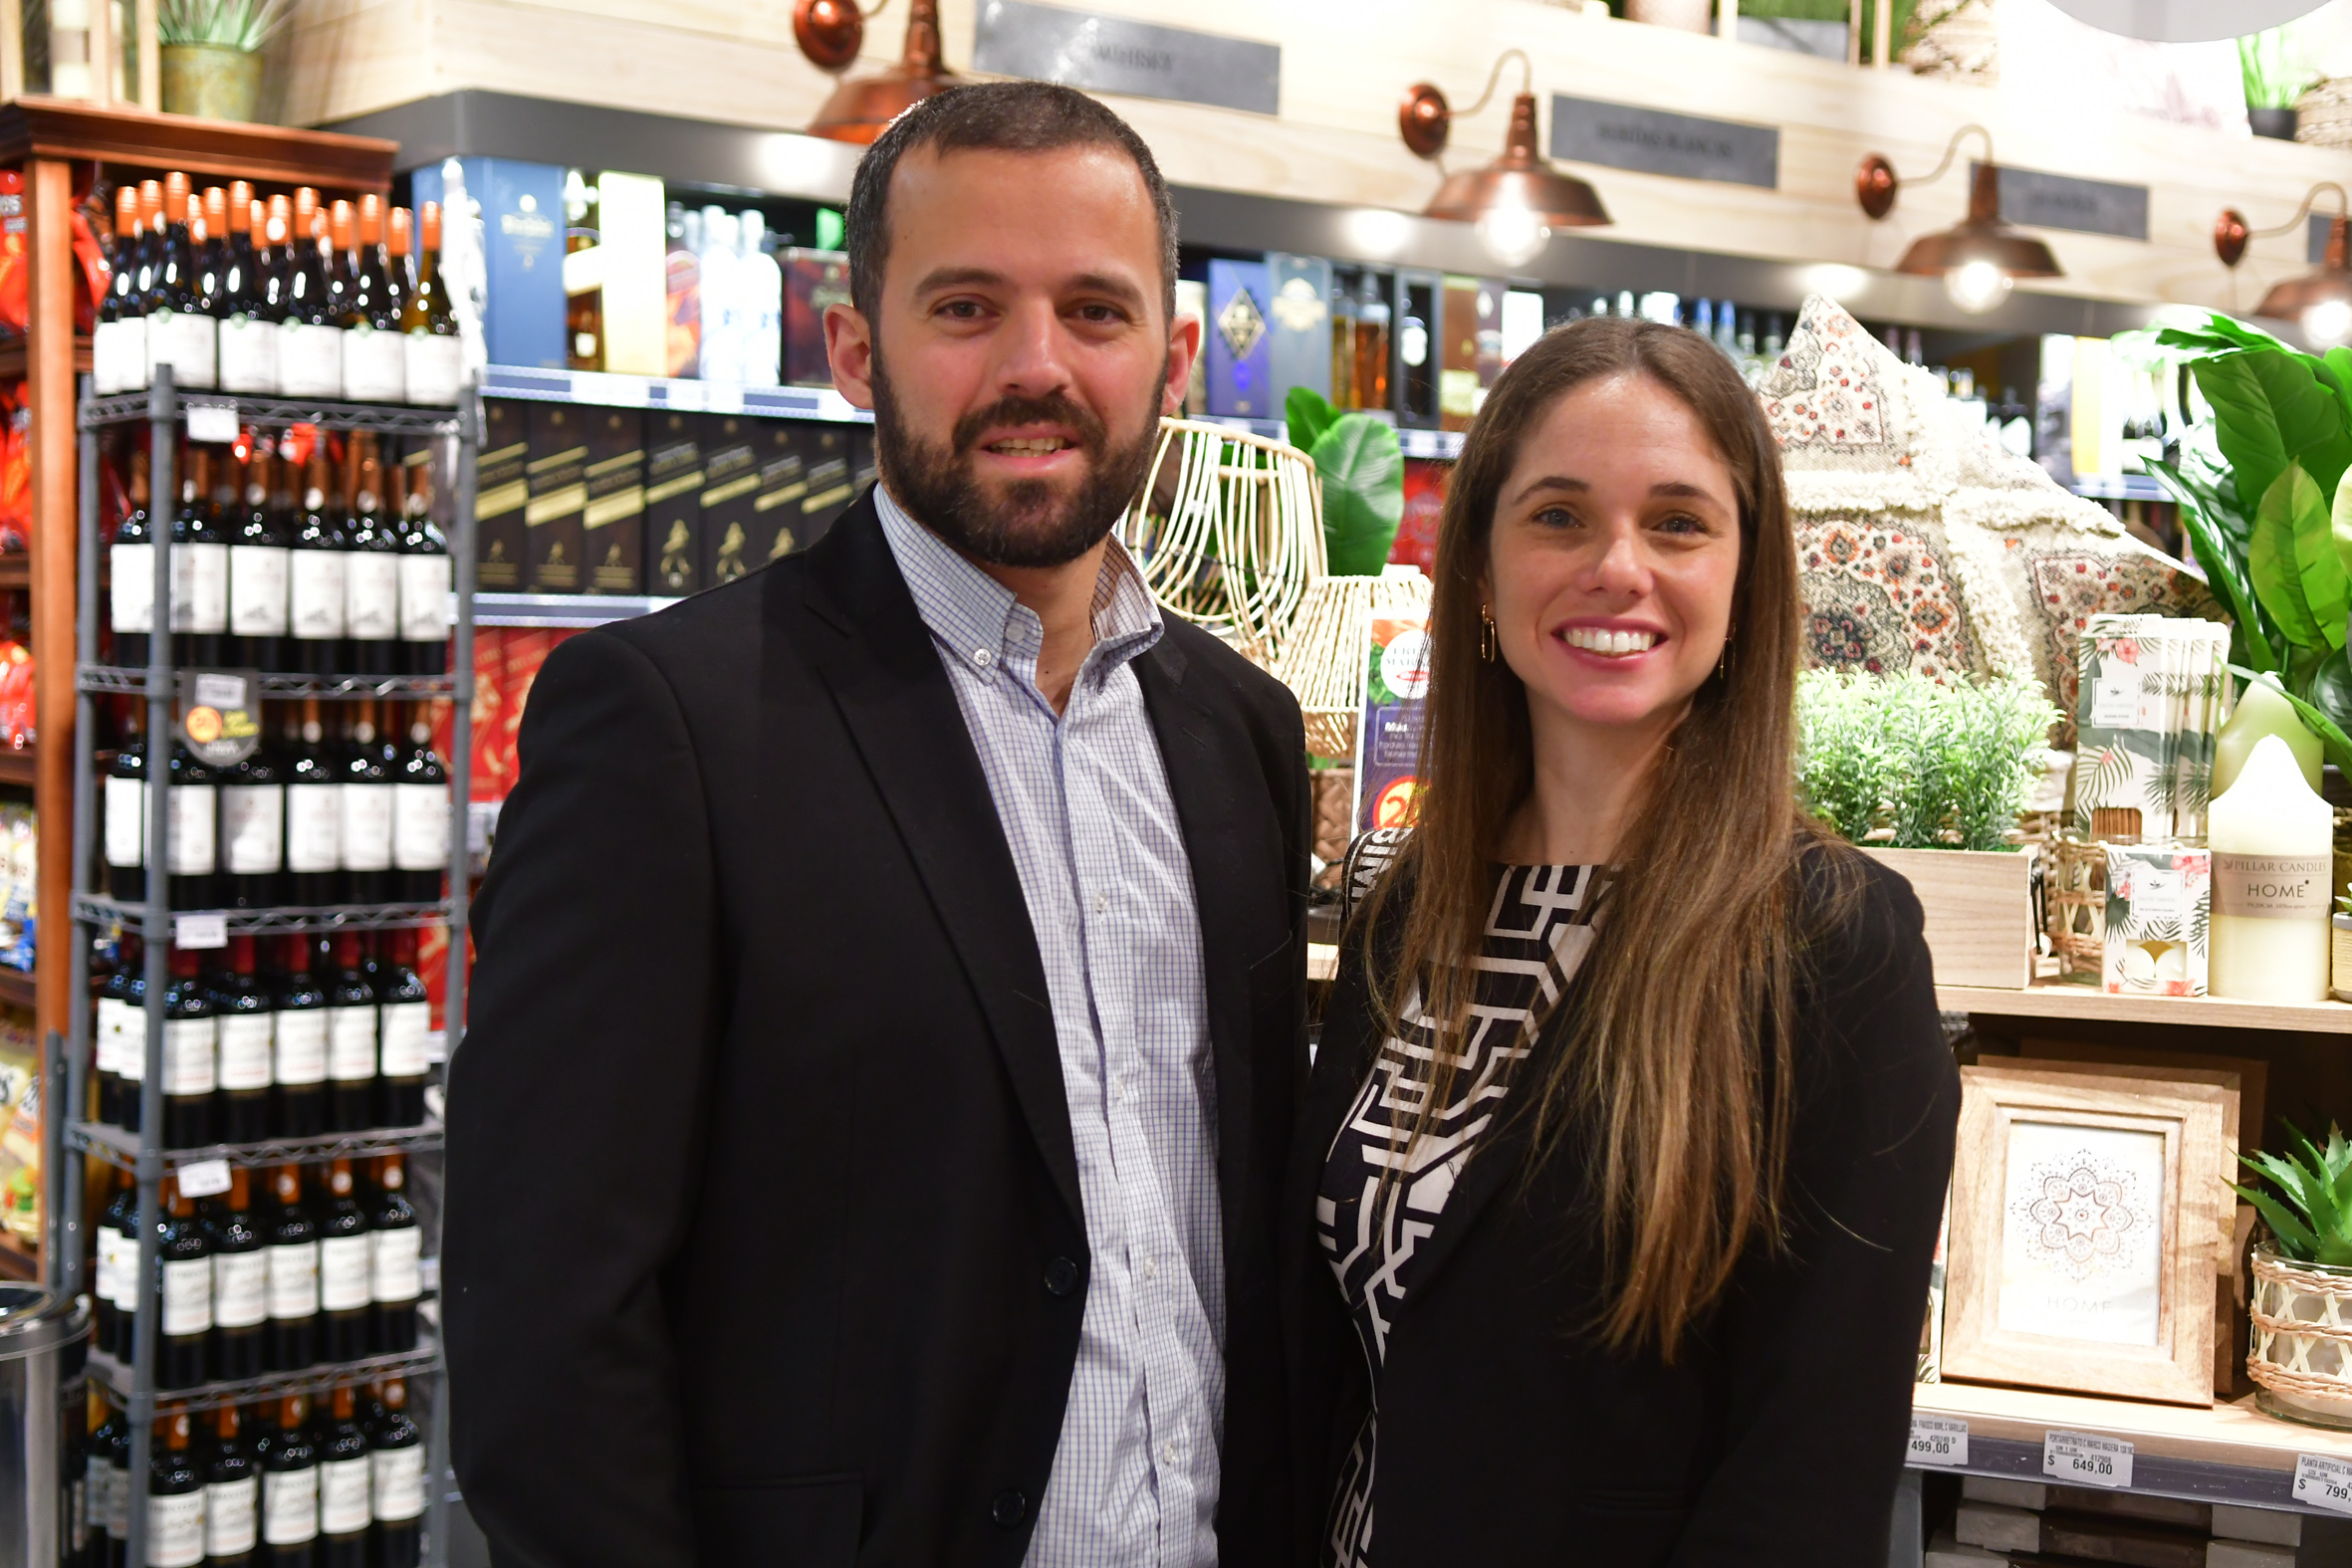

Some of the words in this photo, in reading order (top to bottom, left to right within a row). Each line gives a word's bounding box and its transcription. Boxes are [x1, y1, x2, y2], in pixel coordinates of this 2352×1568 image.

[2234, 861, 2276, 872] PILLAR
[2279, 861, 2327, 873] CANDLES
[2247, 883, 2305, 898] HOME
[1911, 1440, 1950, 1455] 499,00
[2072, 1457, 2113, 1475] 649,00
[2301, 1456, 2318, 1468] PLANTA
